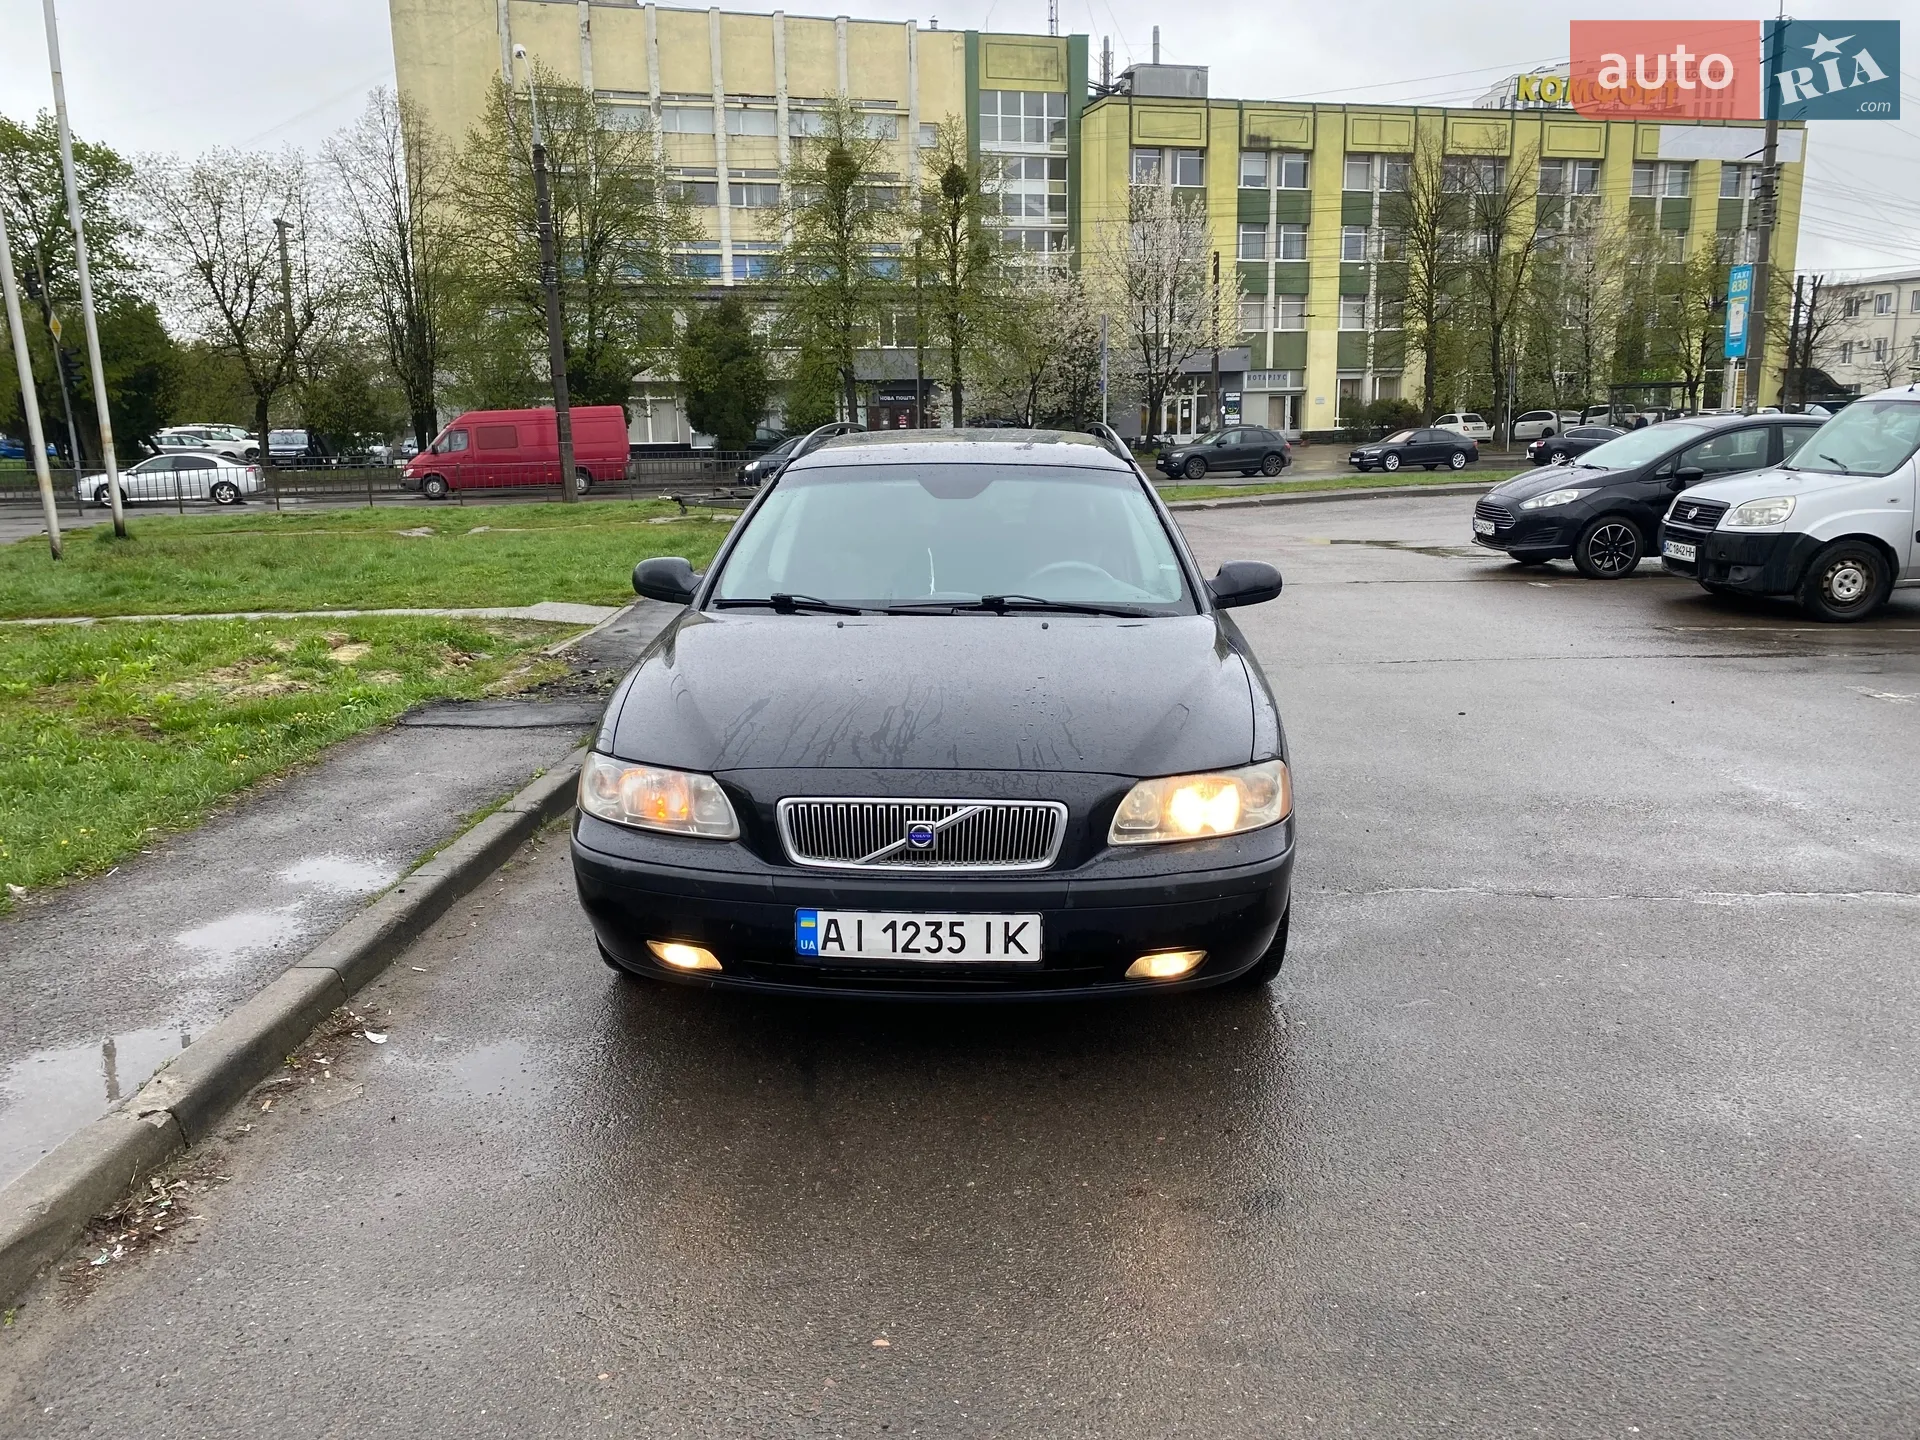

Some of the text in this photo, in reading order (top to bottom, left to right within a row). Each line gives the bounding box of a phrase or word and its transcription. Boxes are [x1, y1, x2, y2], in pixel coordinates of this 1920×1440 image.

[1731, 279, 1748, 292] 838
[820, 918, 1030, 955] AI 1235 IK
[800, 939, 816, 950] UA
